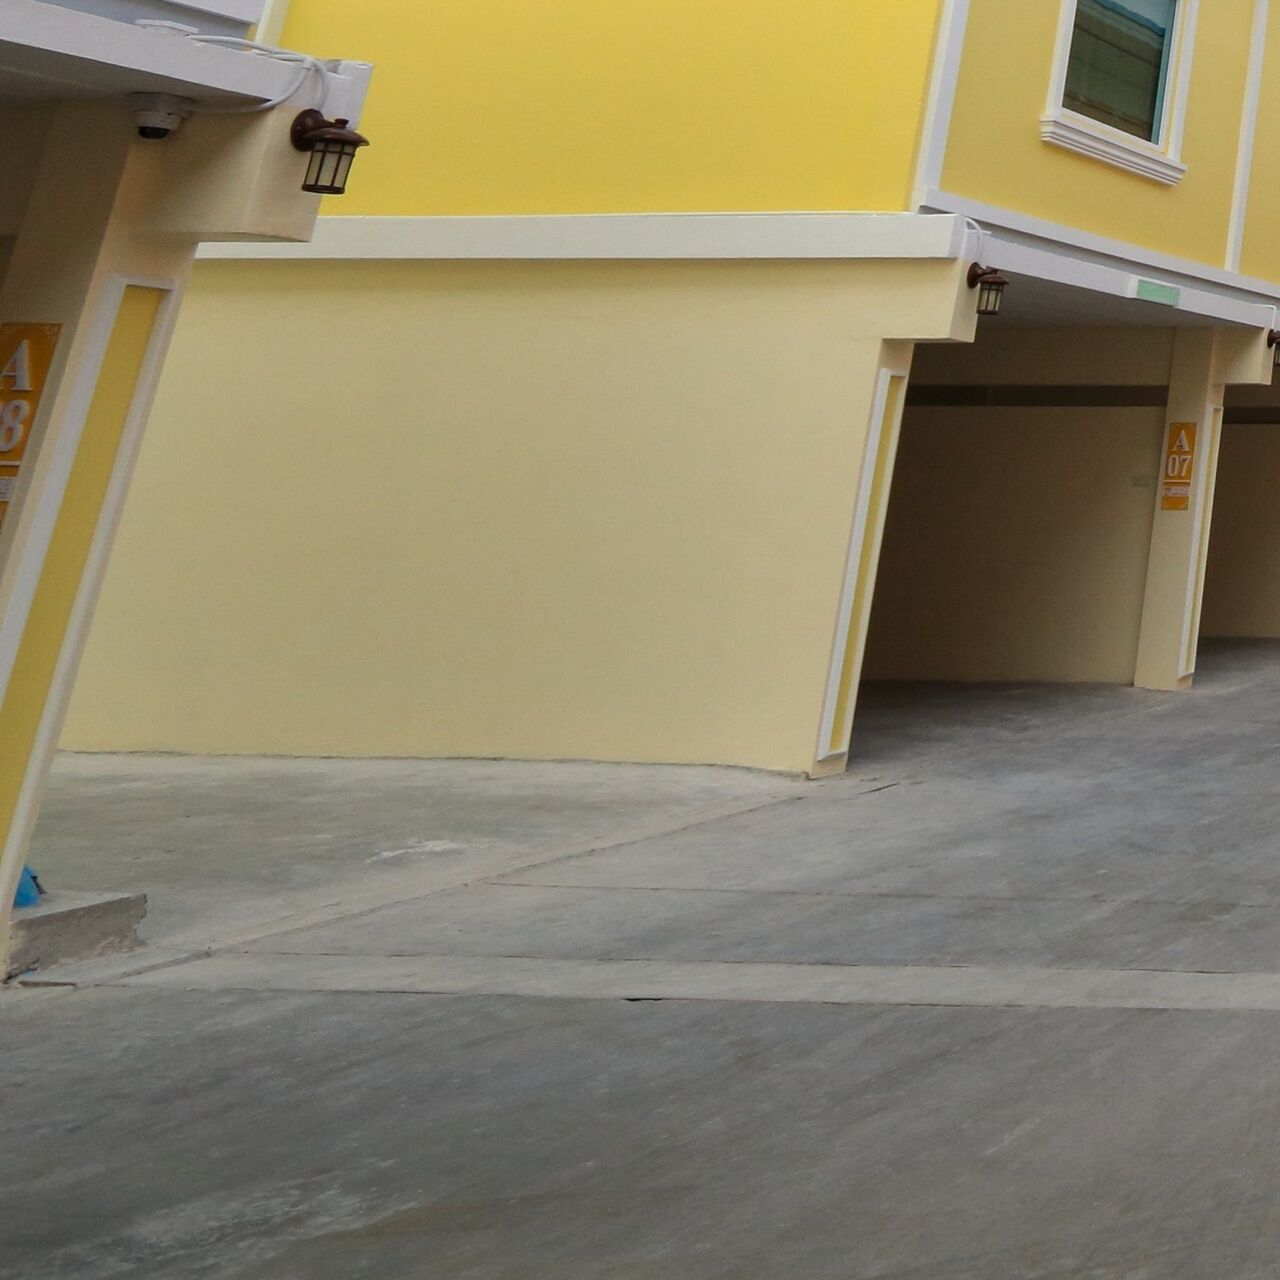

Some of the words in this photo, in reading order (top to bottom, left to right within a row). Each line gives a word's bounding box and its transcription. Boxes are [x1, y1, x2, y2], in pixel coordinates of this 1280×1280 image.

[0, 339, 33, 391] A
[0, 399, 30, 451] 8
[1171, 430, 1190, 452] A
[1167, 455, 1192, 477] 07
